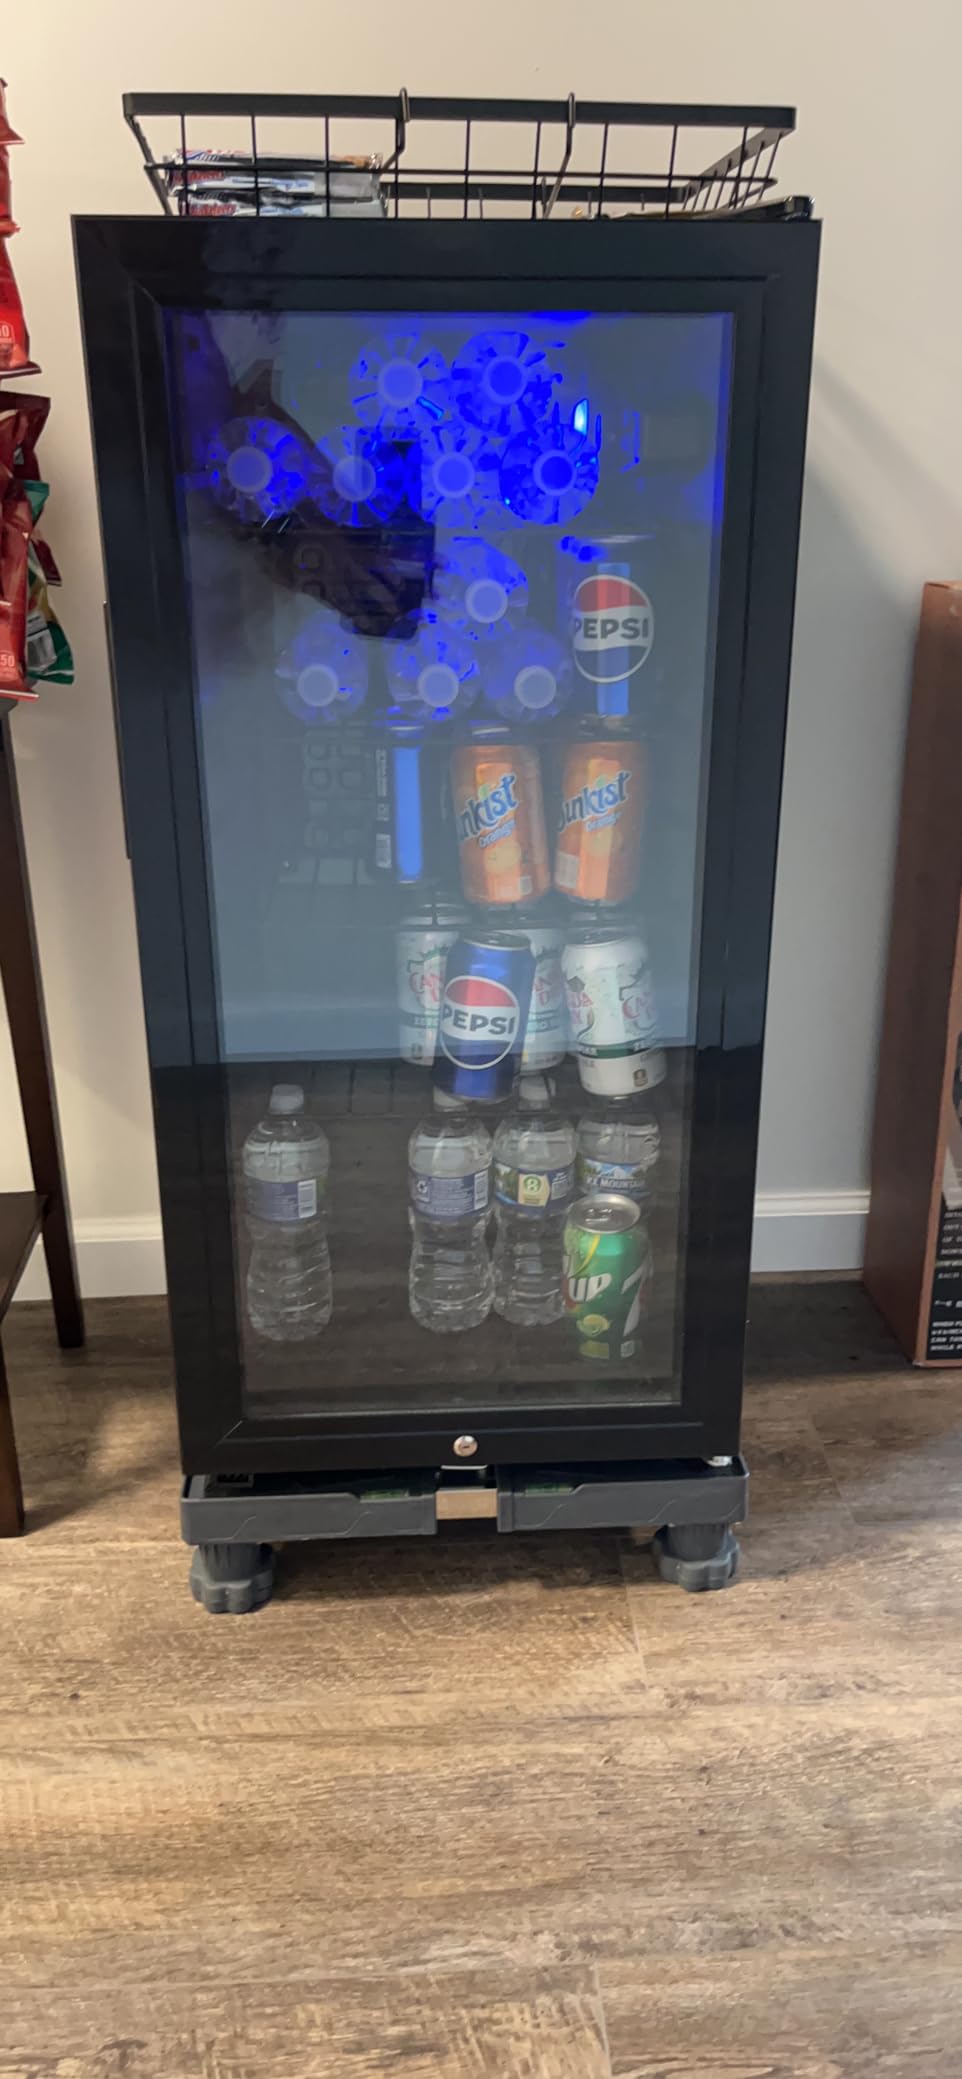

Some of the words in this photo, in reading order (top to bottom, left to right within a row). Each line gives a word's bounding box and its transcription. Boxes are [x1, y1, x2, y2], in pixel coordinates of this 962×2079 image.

[575, 617, 649, 640] PEPSI
[442, 1003, 517, 1036] PEPSI
[568, 1272, 612, 1302] UP
